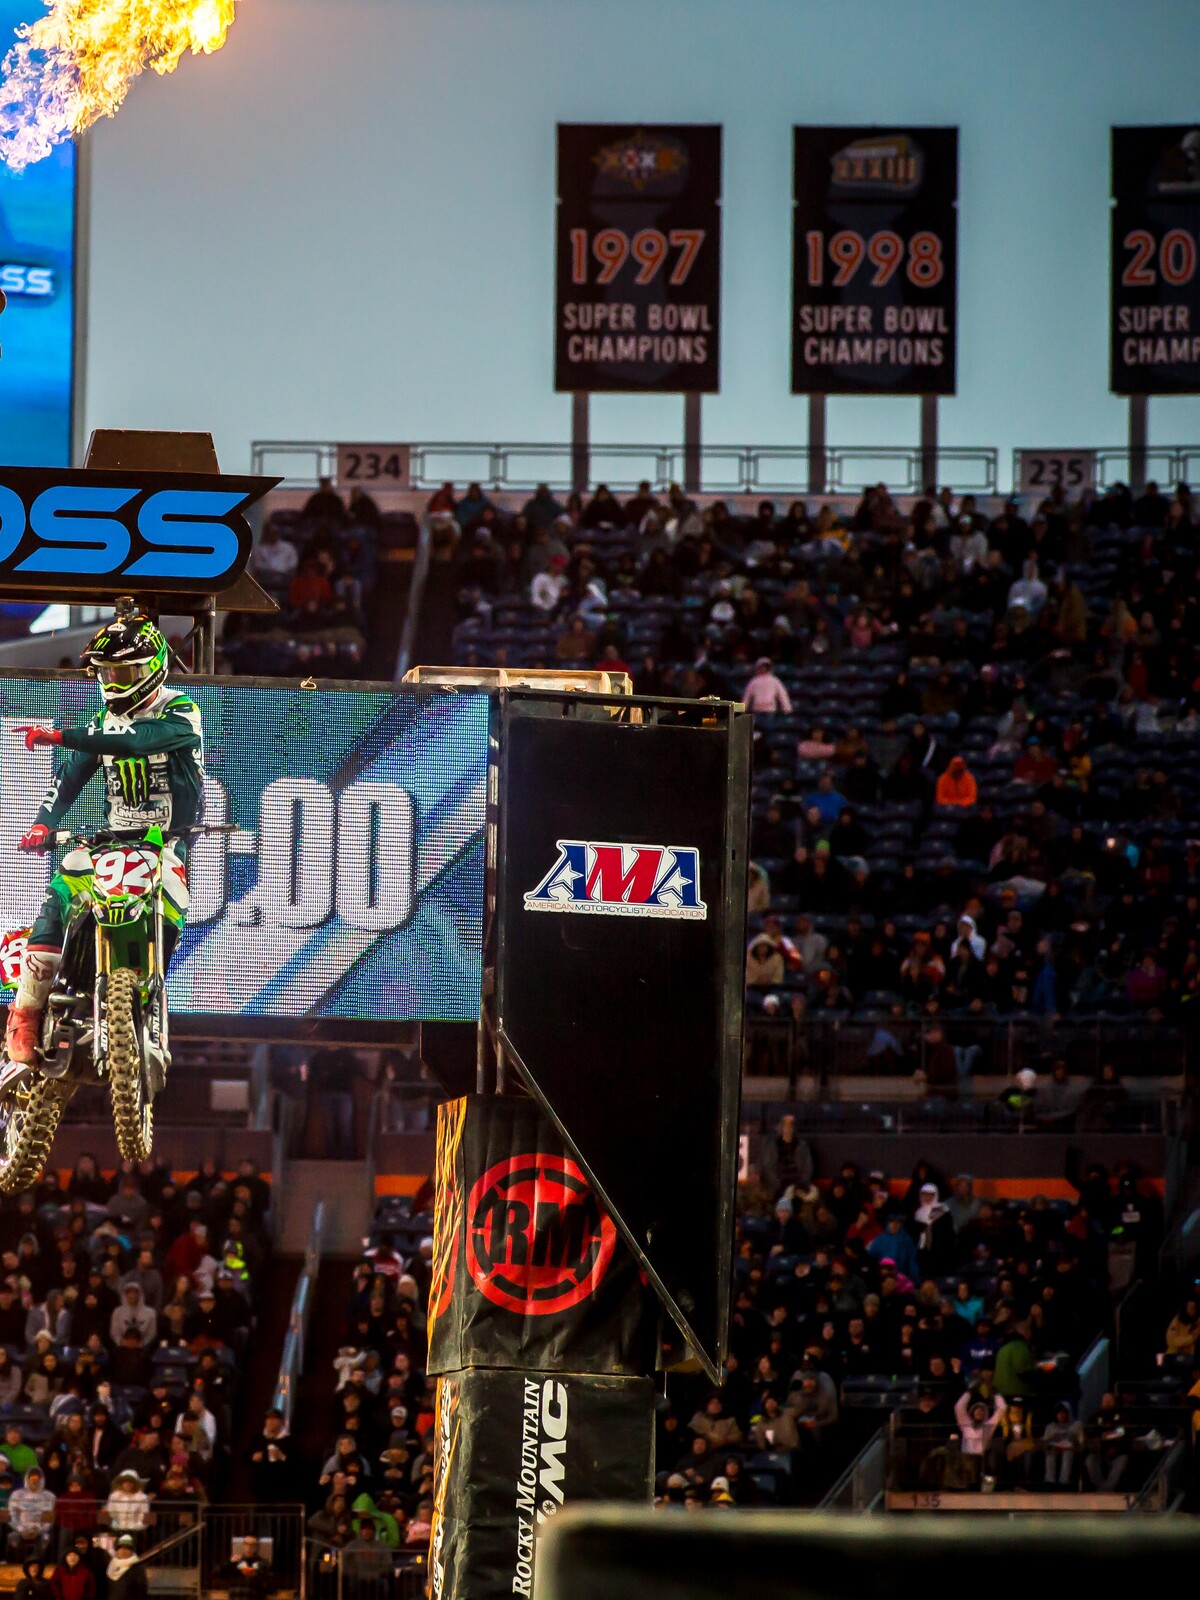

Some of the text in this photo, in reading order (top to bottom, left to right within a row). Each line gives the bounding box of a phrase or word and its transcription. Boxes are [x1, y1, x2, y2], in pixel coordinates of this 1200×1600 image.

[570, 228, 705, 286] 1997
[806, 231, 943, 287] 1998
[563, 303, 712, 333] SUPER BOWL
[800, 305, 949, 334] SUPER BOWL
[1119, 306, 1190, 333] SUPER
[567, 335, 708, 364] CHAMPIONS
[803, 337, 944, 366] CHAMPIONS
[344, 453, 402, 480] 234
[1028, 457, 1084, 487] 235
[95, 850, 159, 892] 92
[527, 842, 704, 909] AMA
[526, 901, 705, 918] AMERICAN MOTORCYCLIST ASSOCIATION
[100, 1001, 109, 1052] DNLOP
[512, 1377, 541, 1599] ROCKY MOUNTAIN
